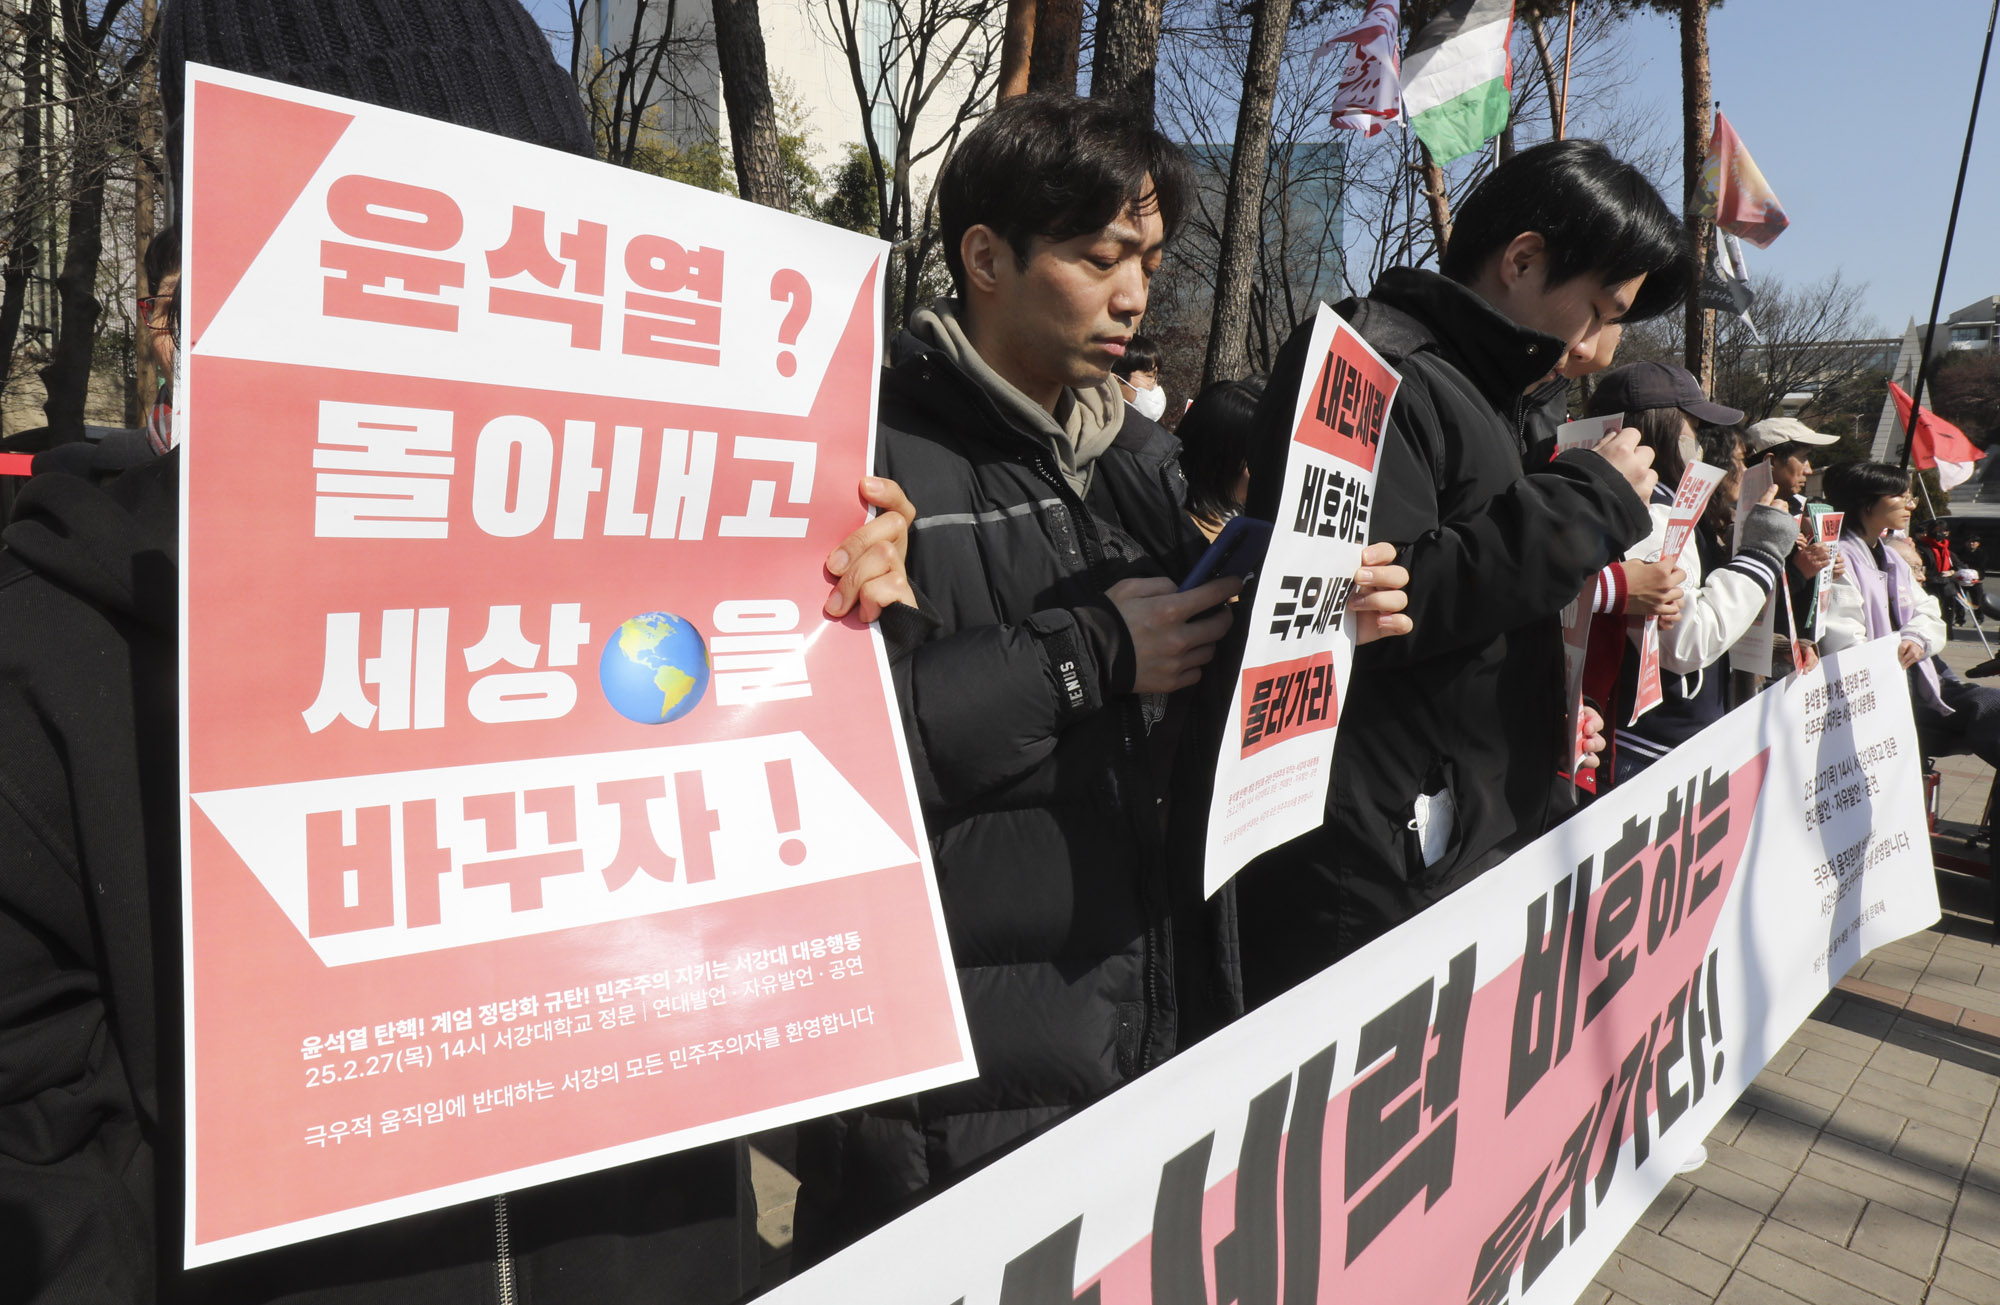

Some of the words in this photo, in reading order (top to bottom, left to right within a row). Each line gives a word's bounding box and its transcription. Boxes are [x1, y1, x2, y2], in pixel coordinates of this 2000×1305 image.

[320, 173, 724, 367] 윤석열
[769, 268, 812, 378] ?
[1316, 350, 1386, 453] 내란세력
[313, 400, 817, 541] 몰아내고
[1293, 464, 1369, 544] 비호하는
[301, 603, 590, 734] 세상
[710, 599, 812, 706] 을
[1270, 576, 1355, 641] 극우세력
[1241, 663, 1333, 749] 물러가라
[1805, 686, 1821, 715] 윤석열
[1883, 737, 1898, 759] 정문
[306, 770, 720, 938] 바꾸자
[764, 758, 807, 866] !
[1813, 858, 1838, 889] 극우적
[300, 1026, 368, 1061] 윤석열
[374, 1017, 425, 1046] 탄핵!
[431, 1007, 473, 1034] 계엄
[478, 995, 539, 1026] 정당화
[544, 987, 590, 1013] 규탄!
[595, 970, 671, 1002] 민주주의
[675, 957, 730, 986] 지키는
[735, 945, 788, 973] 서강대
[792, 930, 862, 961] 대응행동
[305, 1045, 433, 1089] 25.2.27(목)
[440, 1033, 486, 1061] 14시
[493, 1012, 593, 1050] 서강대학교
[598, 1004, 637, 1030] 정문
[652, 984, 727, 1018] 연대발언
[742, 966, 814, 998] 자유발언
[829, 955, 864, 980] 공연
[950, 942, 1478, 1305] 세력
[1505, 765, 1731, 1119] 비호하는
[304, 1114, 372, 1148] 극우적
[379, 1094, 466, 1134] 움직임에
[472, 1080, 555, 1114] 반대하는
[561, 1061, 619, 1092] 서강의
[625, 1053, 664, 1079] 모든
[669, 1026, 780, 1070] 민주주의자를
[785, 1004, 875, 1043] 환영합니다
[1465, 947, 1724, 1305] 물러가라!
